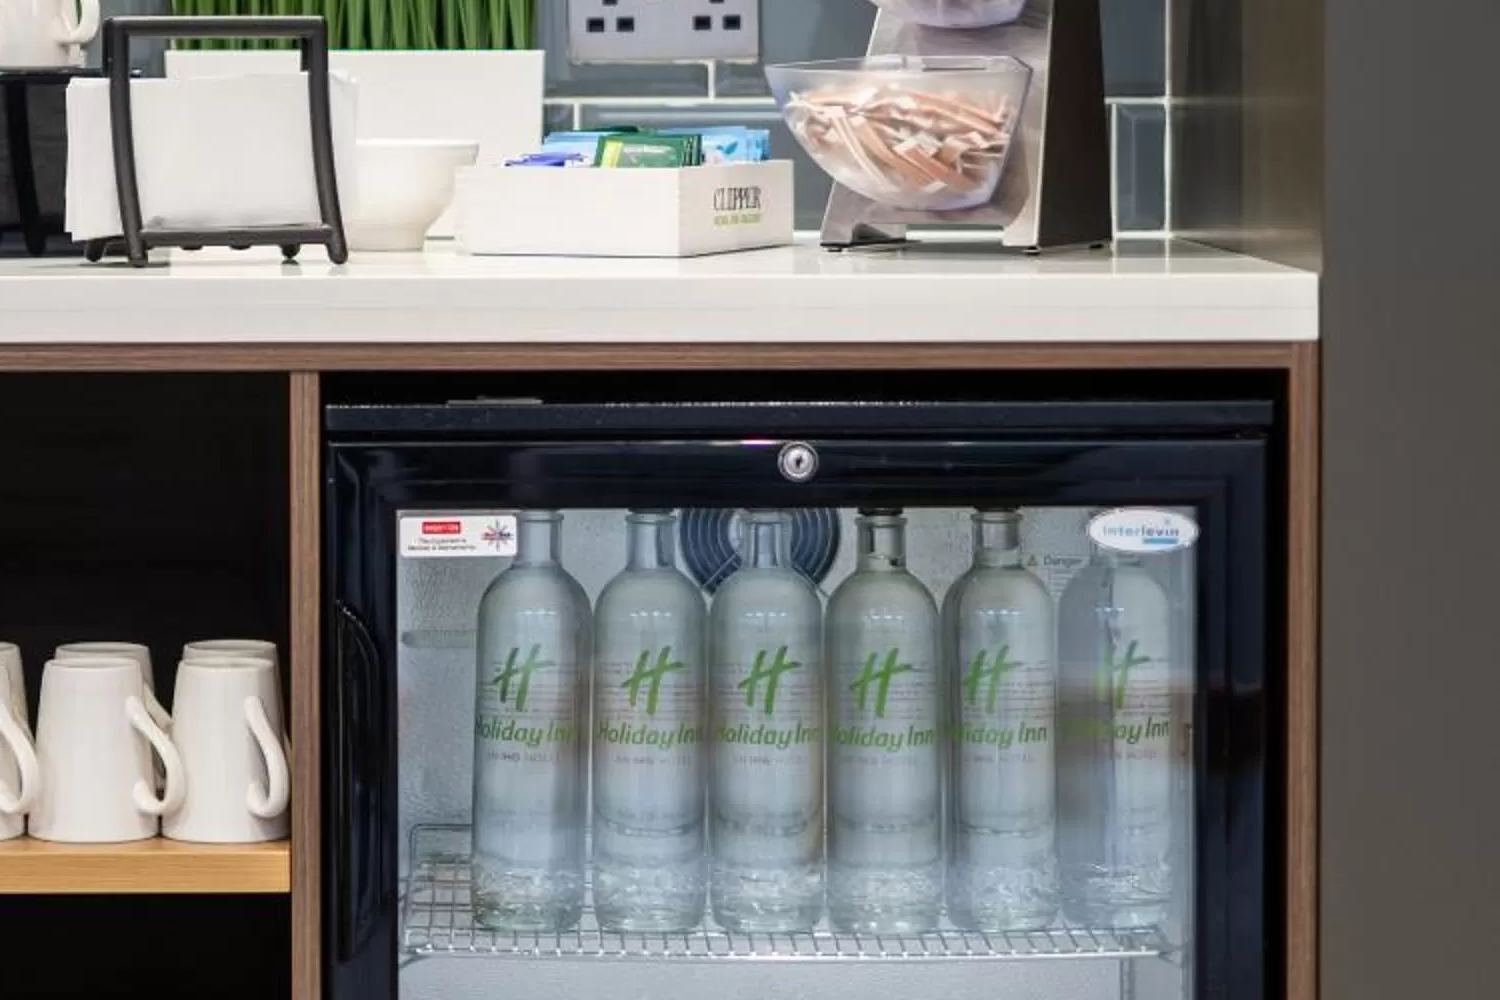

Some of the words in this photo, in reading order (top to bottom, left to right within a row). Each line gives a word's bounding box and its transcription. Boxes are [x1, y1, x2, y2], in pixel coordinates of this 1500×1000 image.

[713, 187, 762, 211] CLIPPER
[493, 644, 557, 712] H
[621, 645, 684, 715] H
[738, 645, 803, 715] H
[849, 647, 912, 718] H
[964, 643, 1024, 713] H
